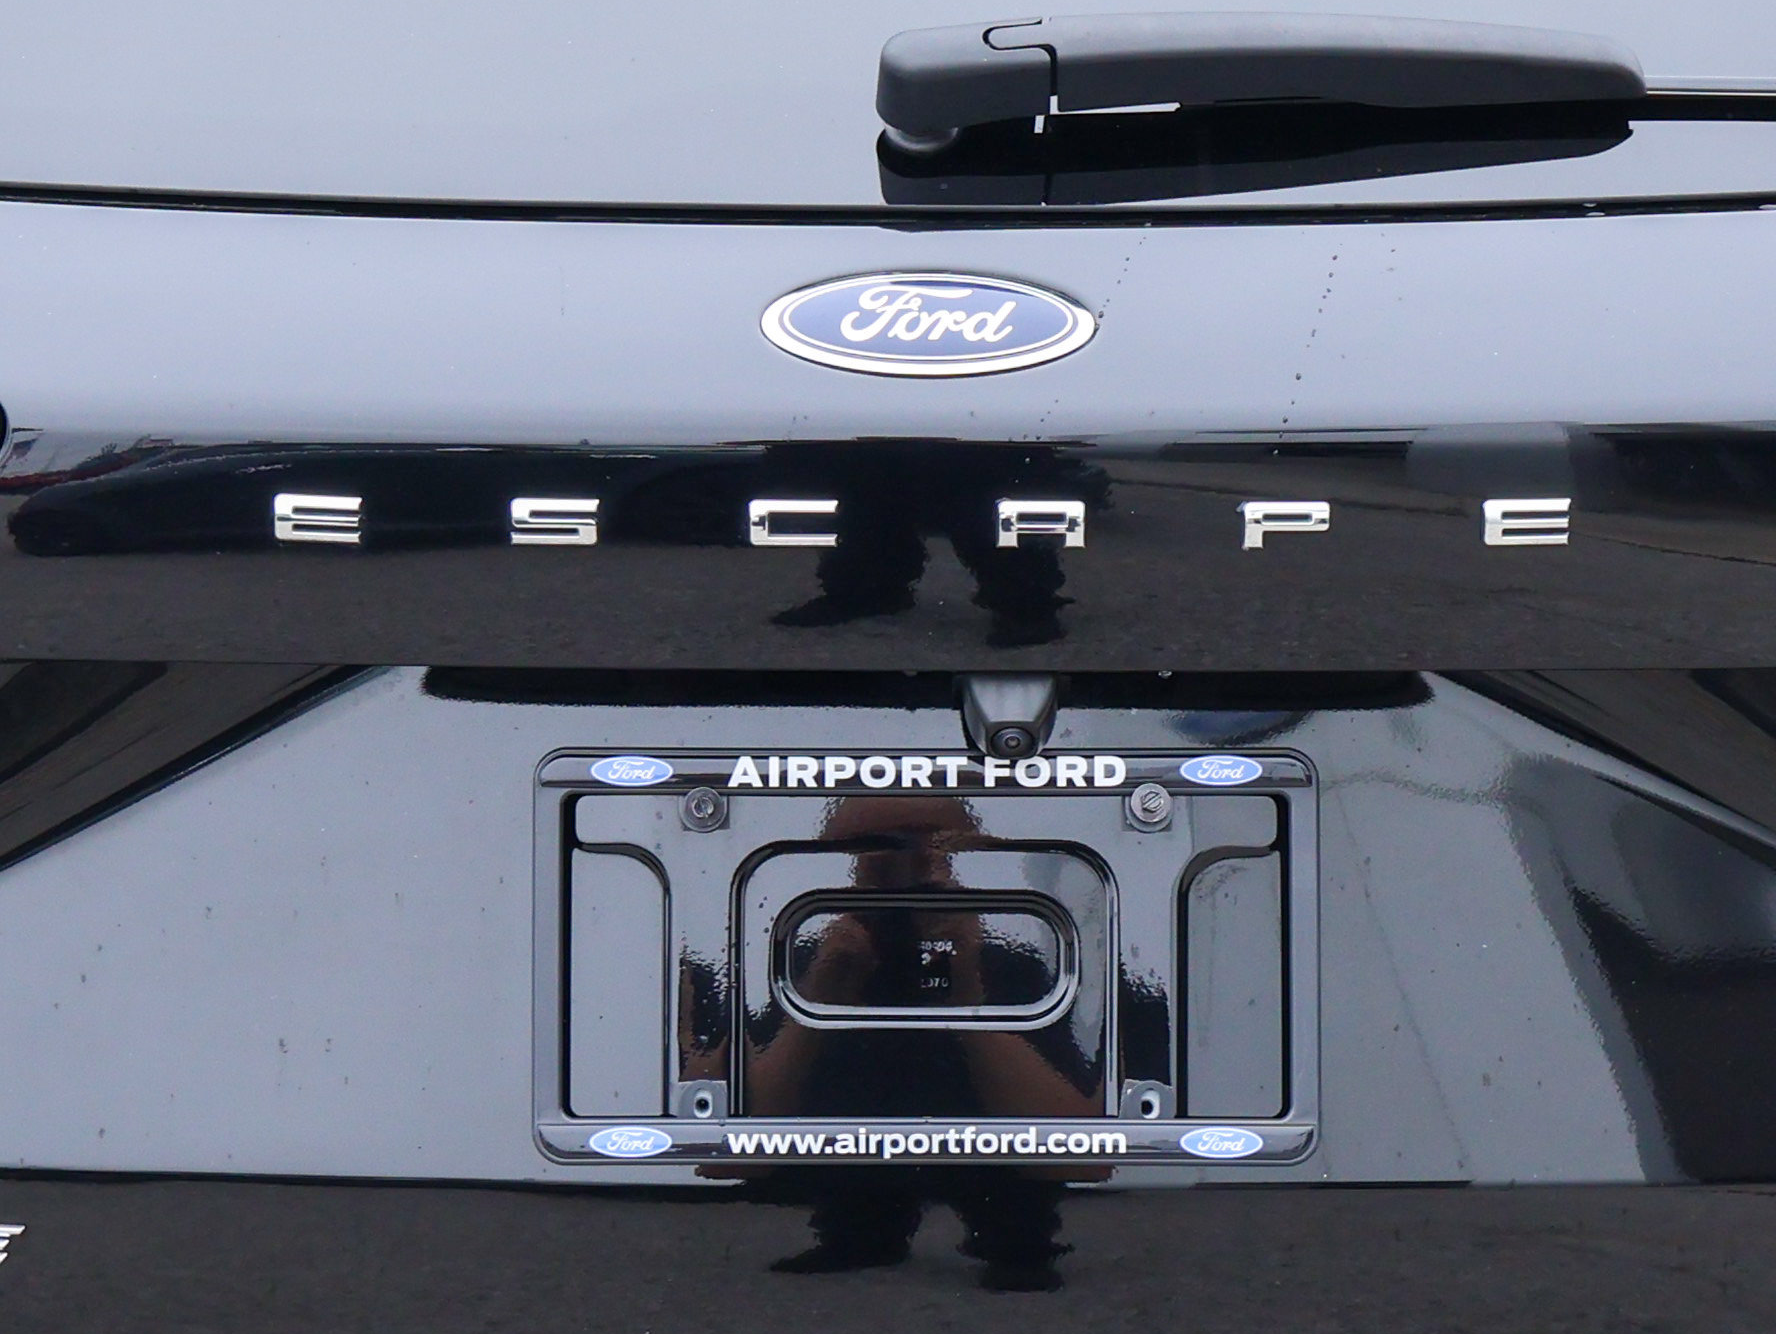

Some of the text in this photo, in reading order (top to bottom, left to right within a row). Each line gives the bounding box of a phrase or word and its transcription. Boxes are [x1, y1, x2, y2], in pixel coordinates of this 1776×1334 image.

[839, 284, 1018, 343] Ford
[273, 492, 1574, 549] ESCAPE
[607, 760, 656, 780] Ford
[727, 755, 1127, 788] AIRPORT FORD
[1197, 759, 1246, 779] Ford
[606, 1131, 655, 1152] Ford
[727, 1127, 1128, 1159] www.airportford.com
[1197, 1131, 1246, 1152] Ford
